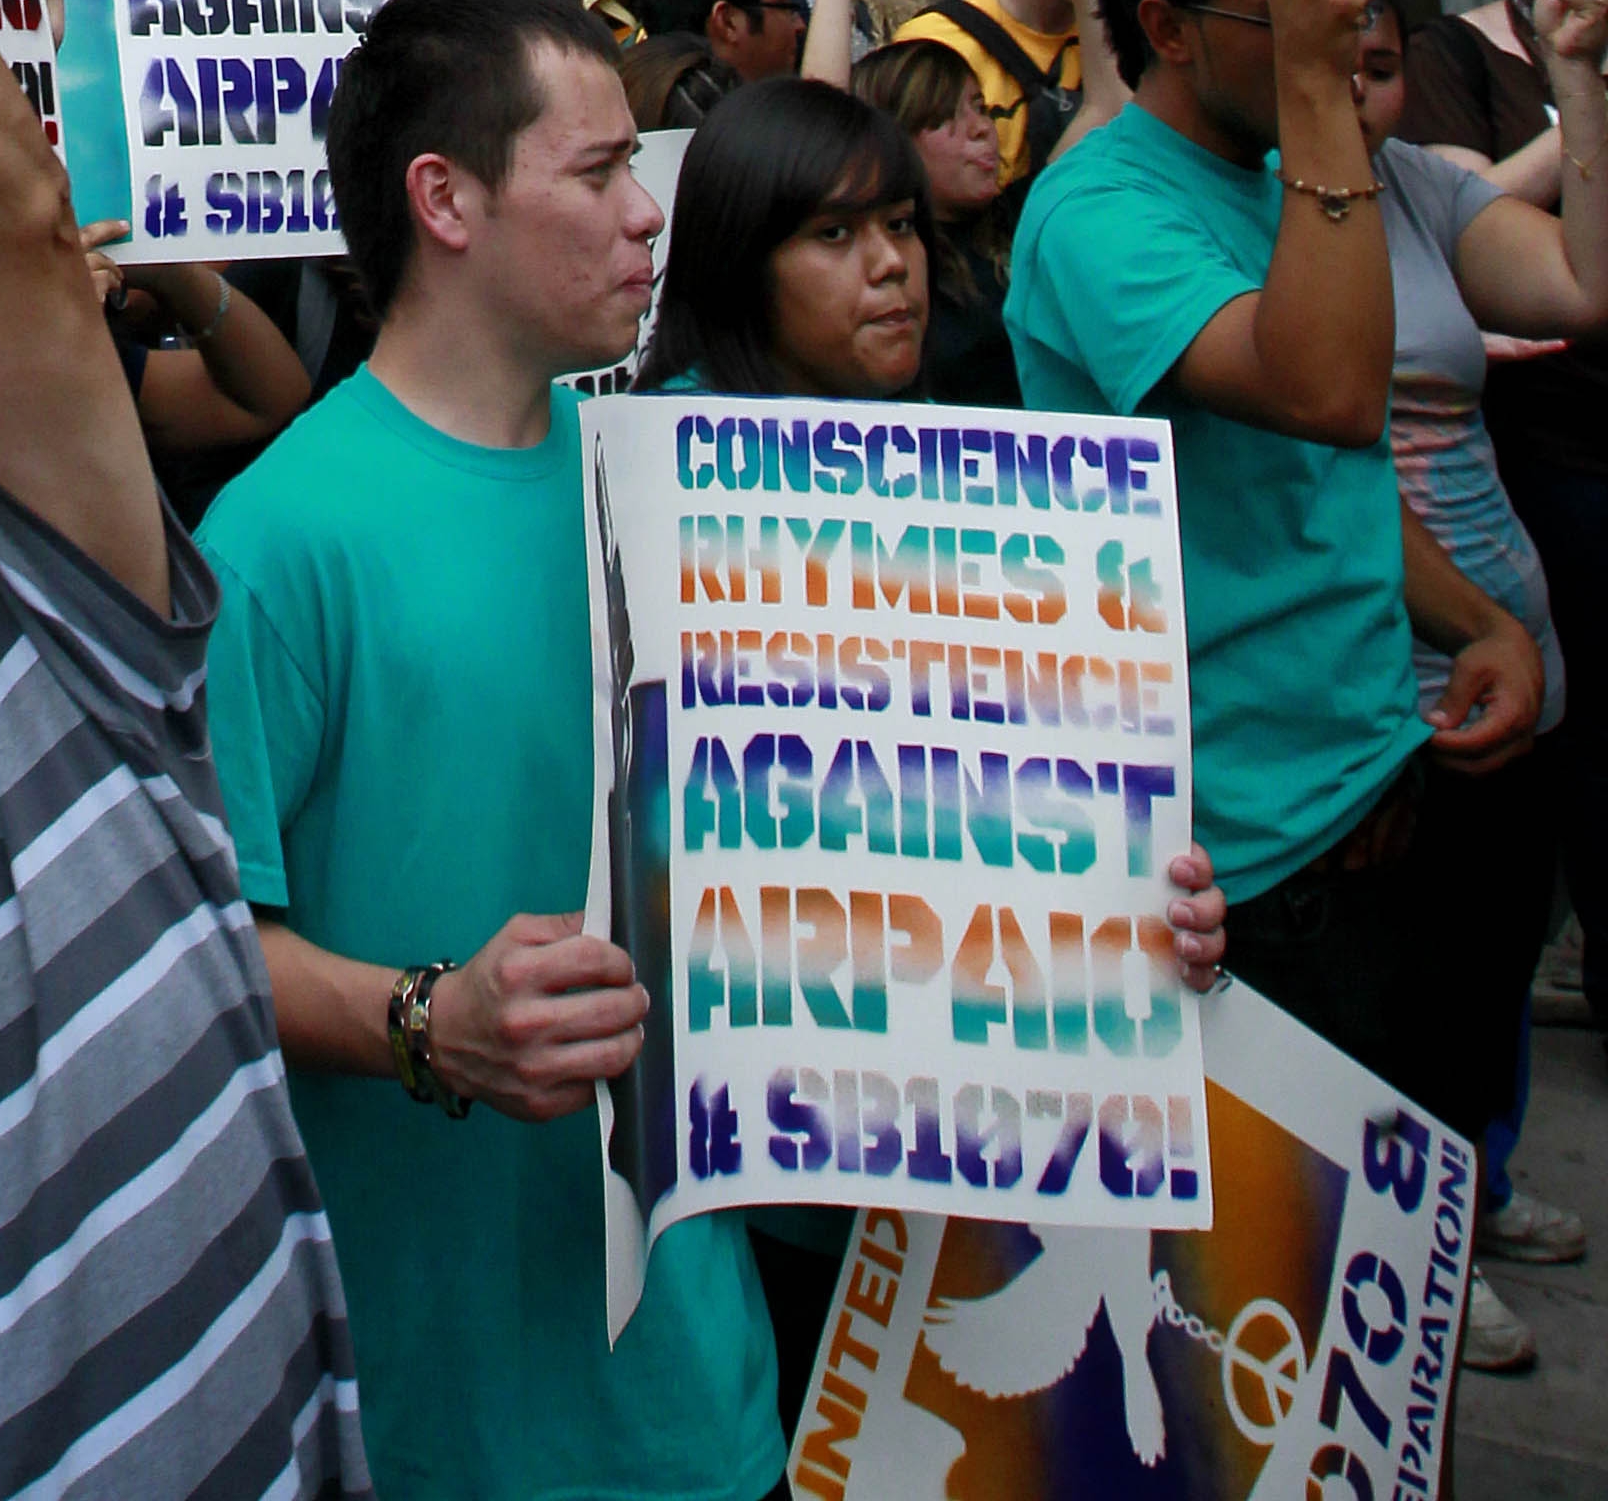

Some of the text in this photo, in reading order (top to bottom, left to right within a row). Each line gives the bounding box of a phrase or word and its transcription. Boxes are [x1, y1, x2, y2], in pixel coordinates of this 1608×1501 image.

[145, 173, 188, 238] &
[676, 415, 1162, 519] CONSCIENCE
[680, 516, 1169, 634] RHYMES &
[681, 630, 1176, 736] RESISTENCE
[684, 733, 1176, 879] AGAINST
[688, 886, 1186, 1059] ARPAIO
[689, 1067, 1199, 1200] & SB1070!
